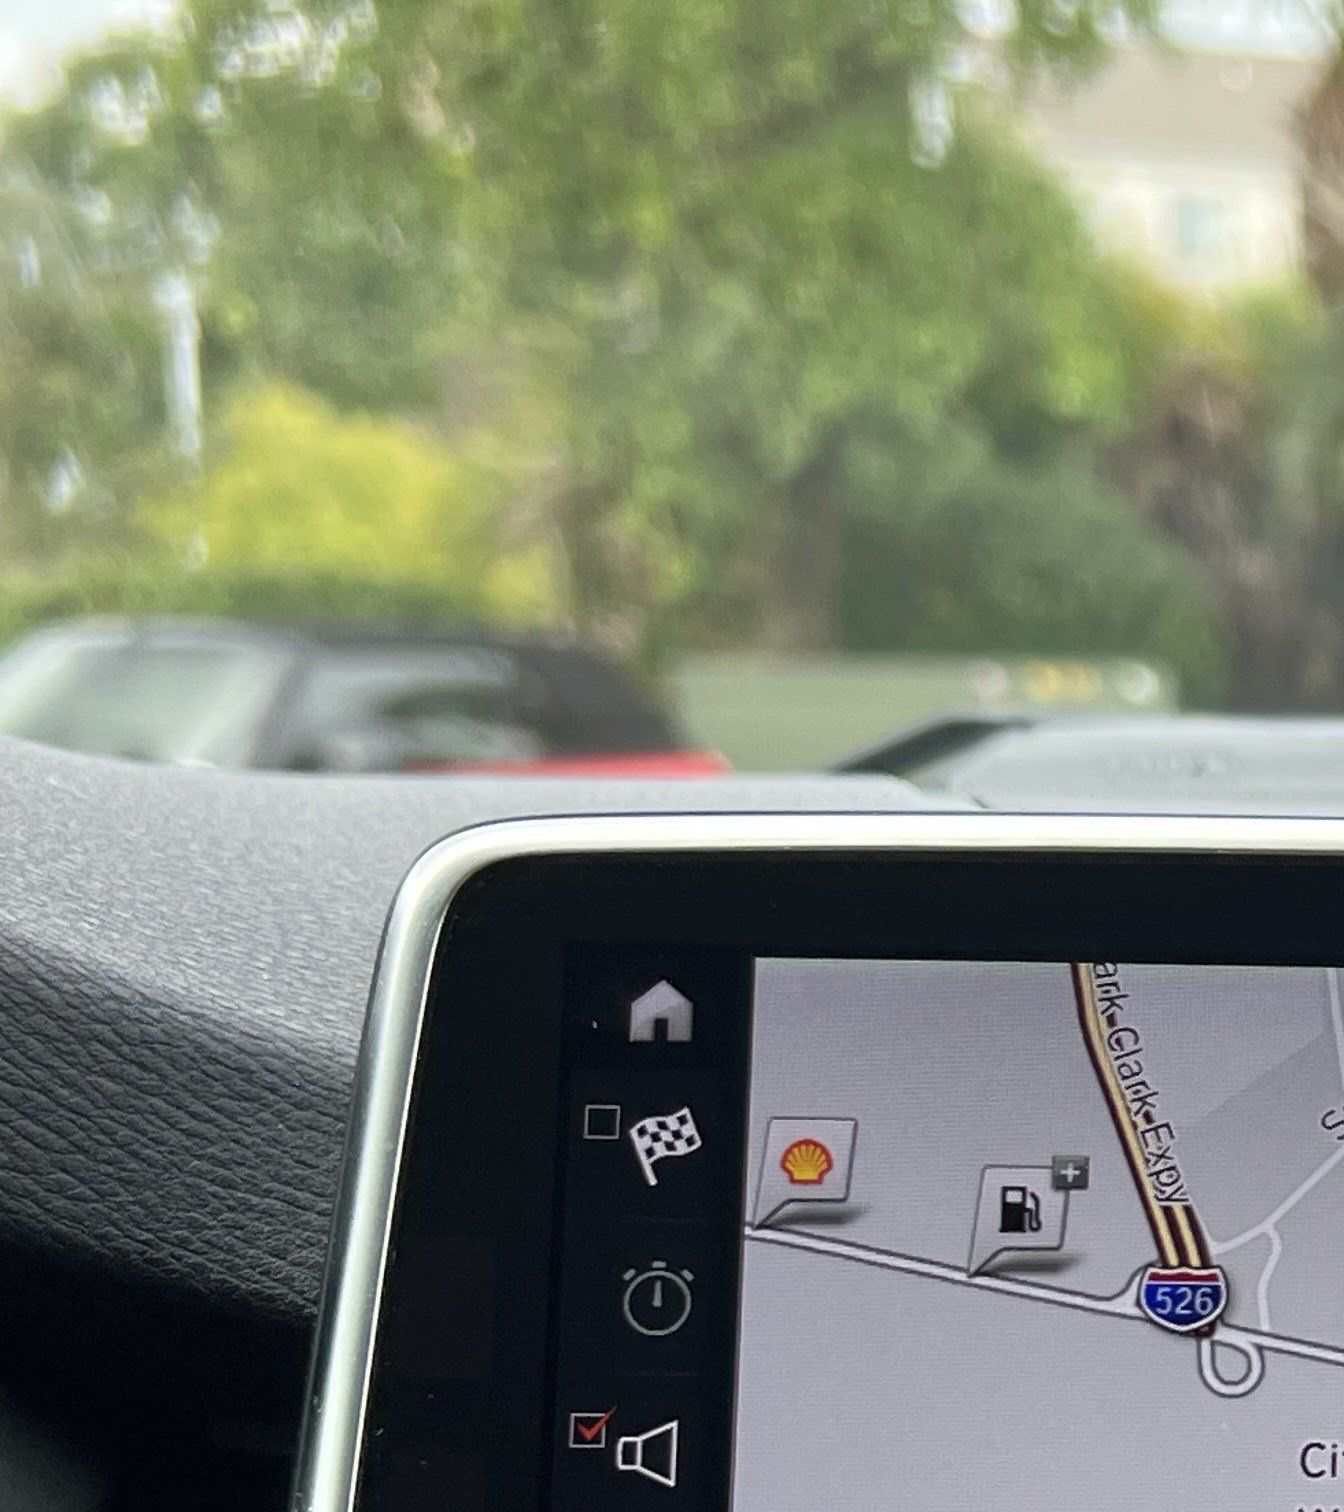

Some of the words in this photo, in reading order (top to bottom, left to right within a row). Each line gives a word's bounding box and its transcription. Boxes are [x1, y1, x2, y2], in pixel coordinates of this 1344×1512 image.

[1107, 1027, 1159, 1117] Clark
[1140, 1121, 1190, 1206] Expy
[1155, 1286, 1214, 1316] 526
